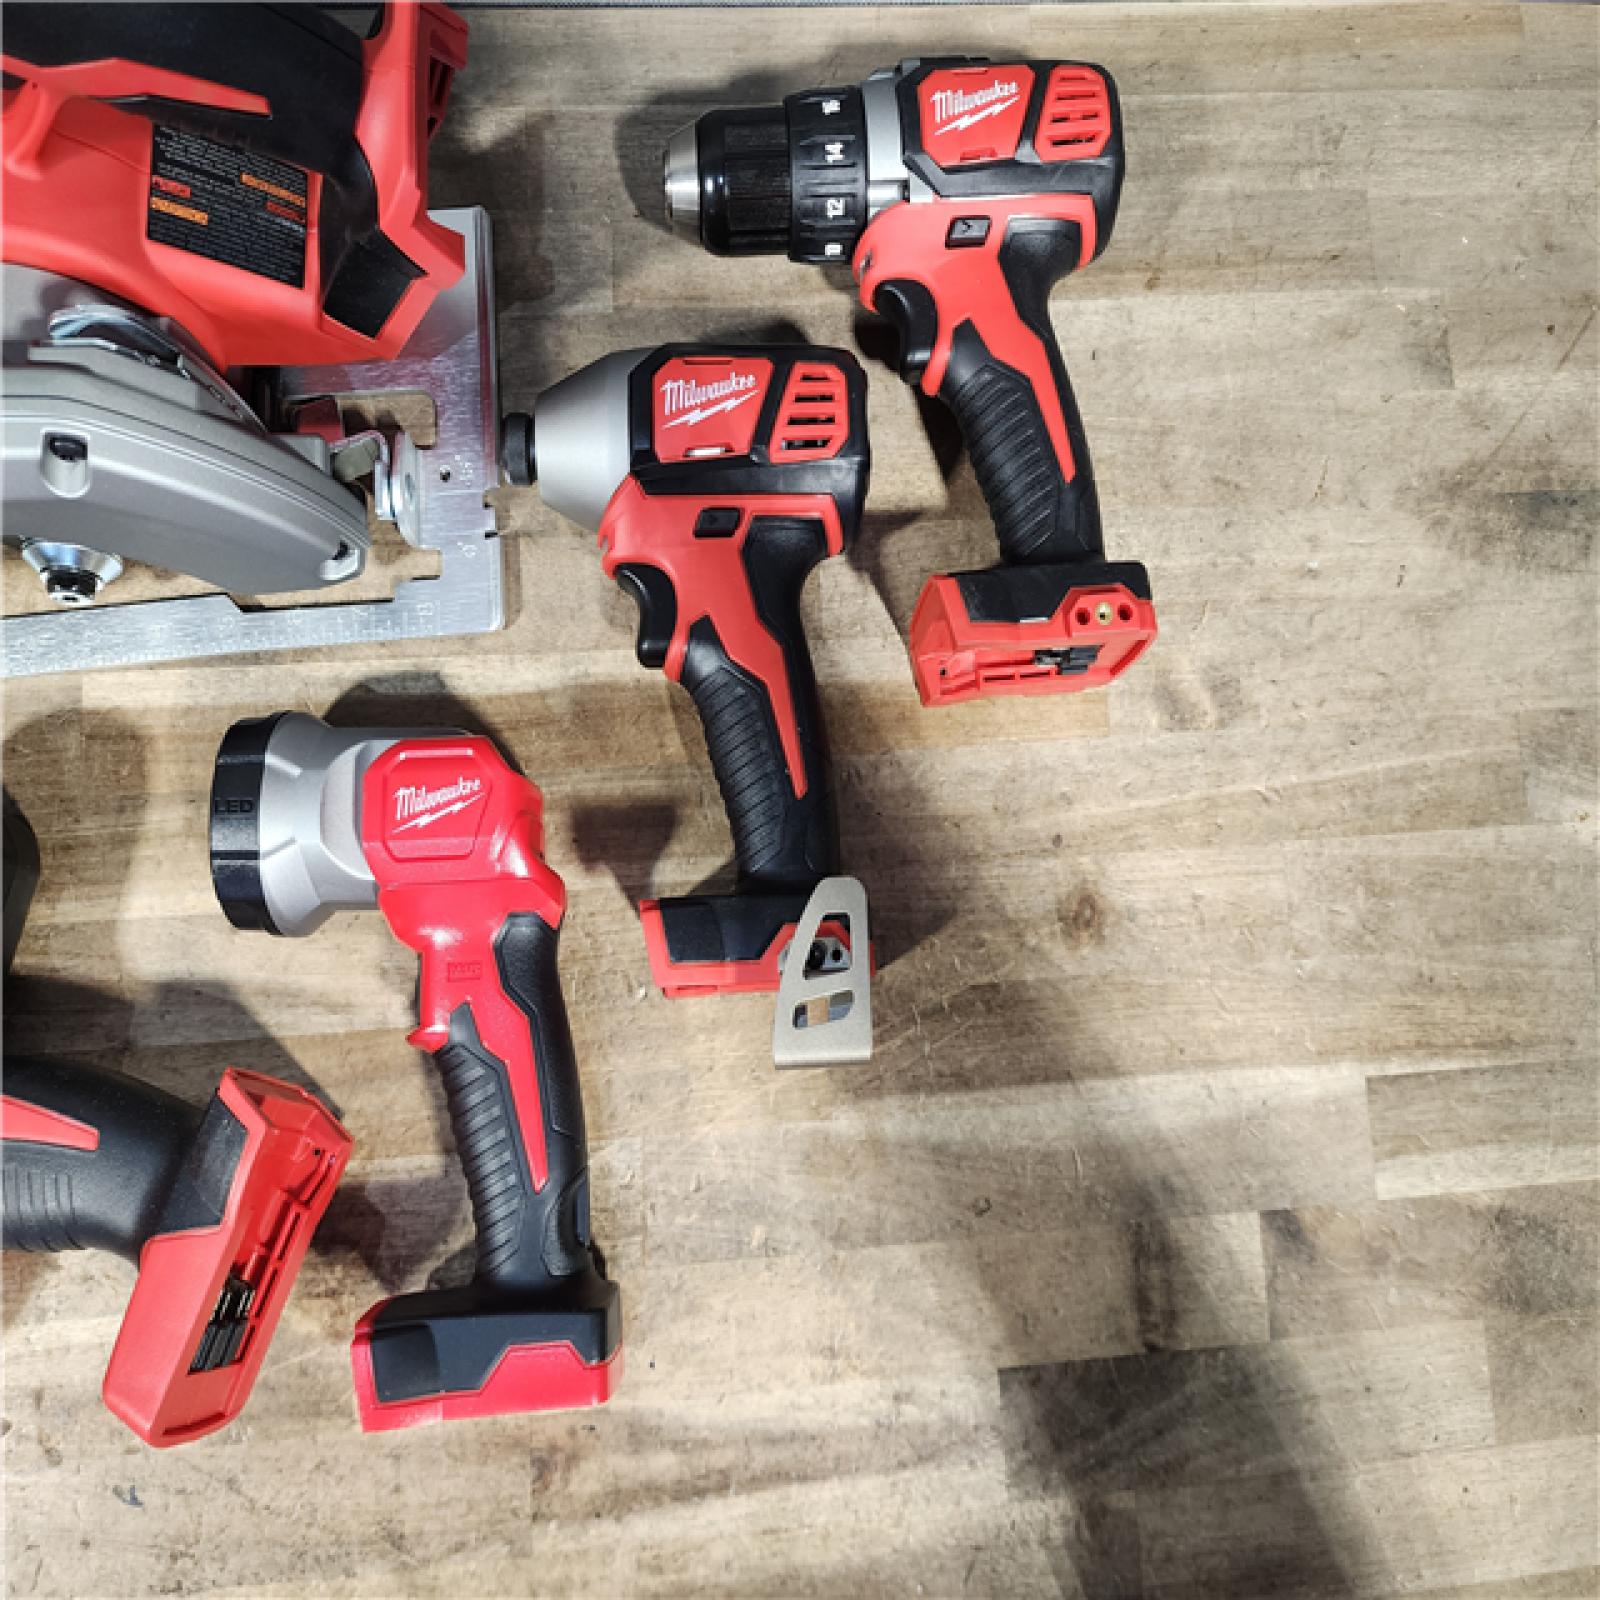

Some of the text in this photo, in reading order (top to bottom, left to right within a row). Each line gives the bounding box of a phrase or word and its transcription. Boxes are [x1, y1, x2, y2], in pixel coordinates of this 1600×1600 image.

[930, 80, 1020, 124] Milwaukee
[660, 371, 757, 416] Milwaukee
[214, 798, 255, 814] LED
[393, 775, 482, 821] Milwaukee
